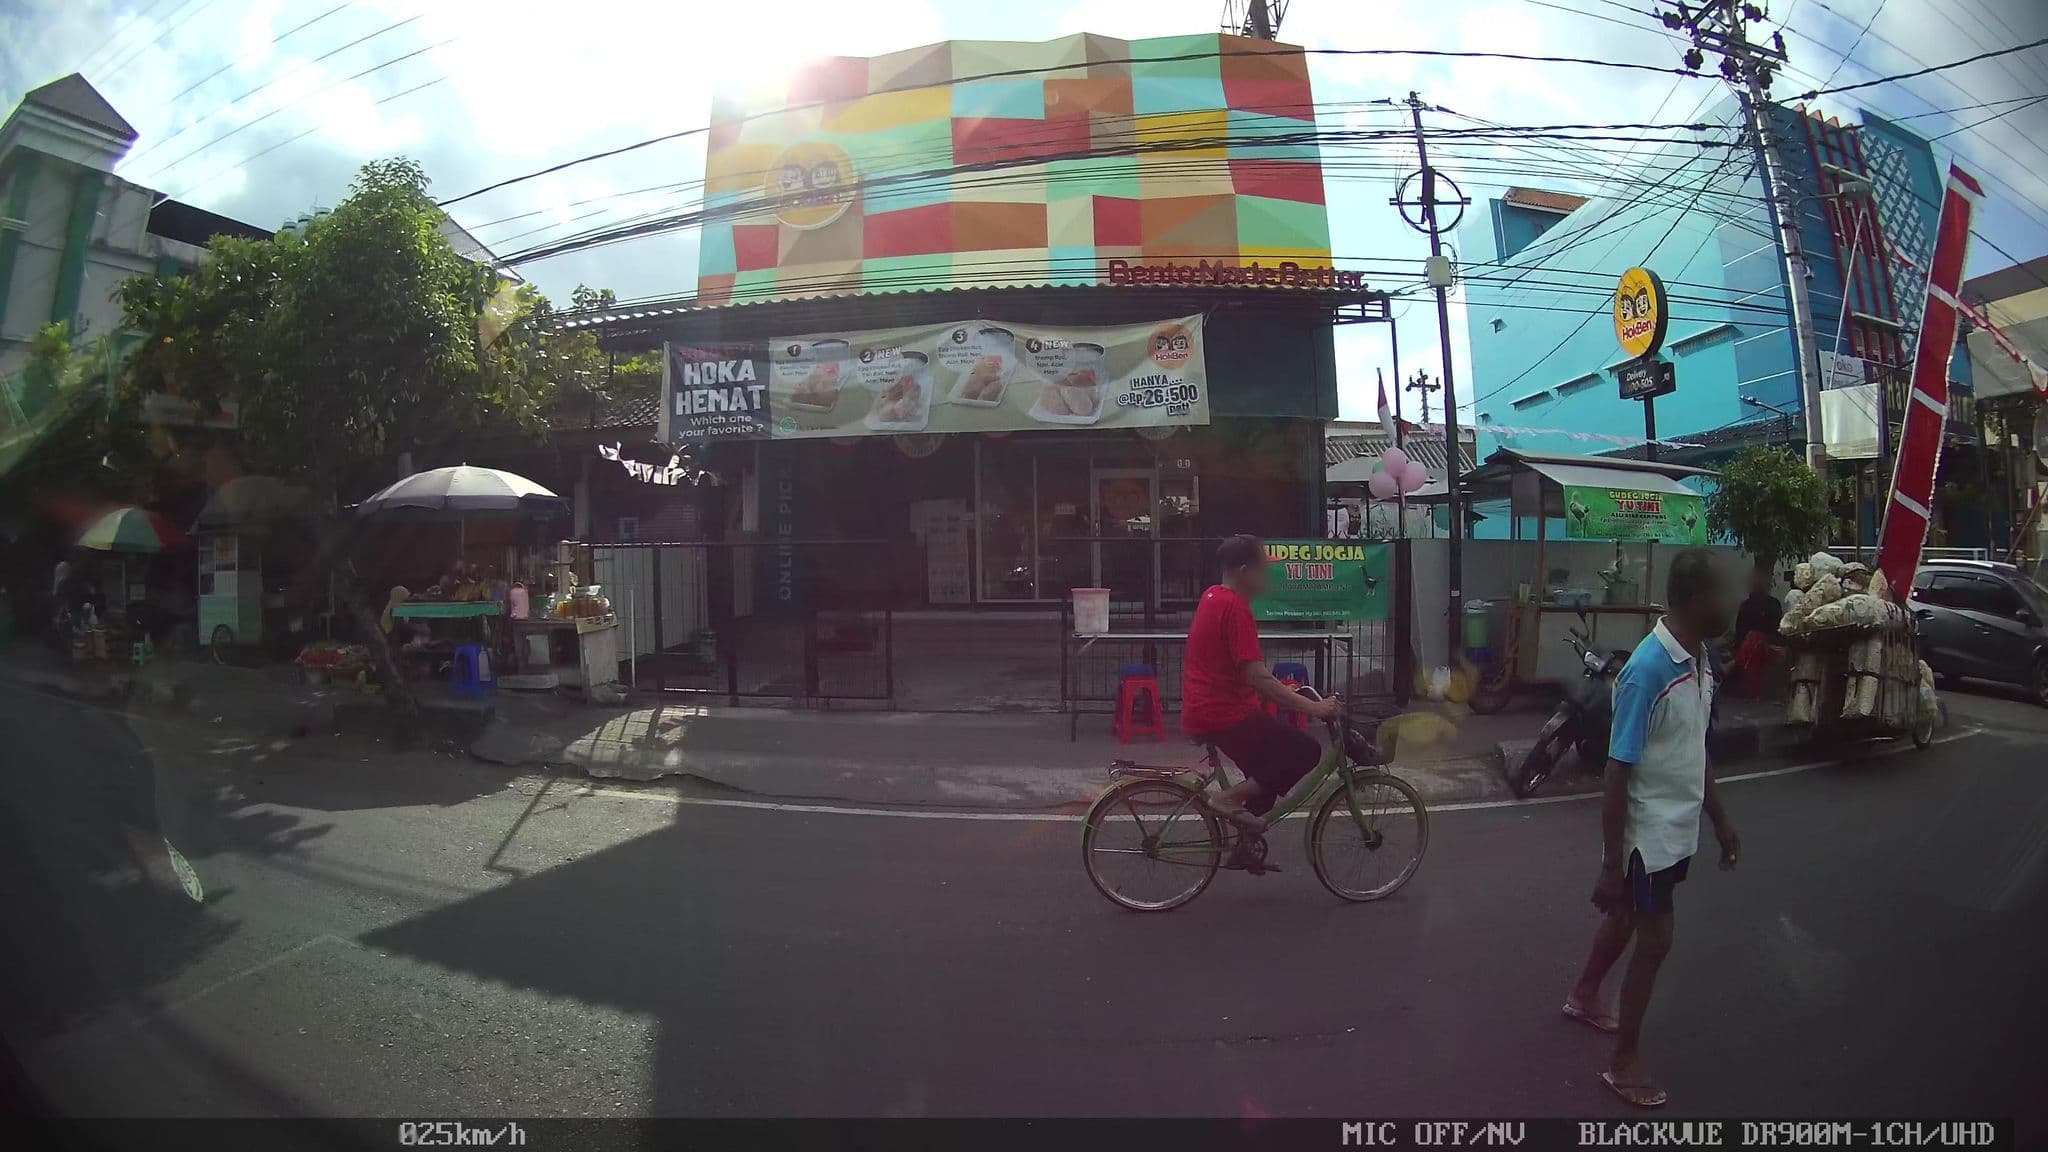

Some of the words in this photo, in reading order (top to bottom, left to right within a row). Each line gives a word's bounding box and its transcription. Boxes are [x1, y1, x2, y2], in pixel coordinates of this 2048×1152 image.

[1109, 260, 1193, 285] Bento
[1199, 259, 1274, 286] Made
[1279, 261, 1365, 289] Better
[1622, 320, 1652, 341] HokBen
[1031, 340, 1038, 350] 4
[1045, 340, 1069, 350] NEW
[864, 351, 871, 361] 2
[877, 346, 901, 359] NEW
[684, 359, 757, 386] HOKA
[675, 384, 766, 416] HEMAT
[690, 415, 726, 427] Which
[729, 414, 753, 423] one
[679, 428, 705, 439] your
[708, 424, 753, 436] favorite
[1609, 491, 1640, 500] GUDEG
[1616, 500, 1635, 512] YU
[1264, 545, 1311, 560] UDEG
[1315, 545, 1365, 560] JOGJA
[779, 522, 792, 601] ONLINE
[1286, 563, 1302, 580] YU
[1306, 563, 1334, 580] TINI
